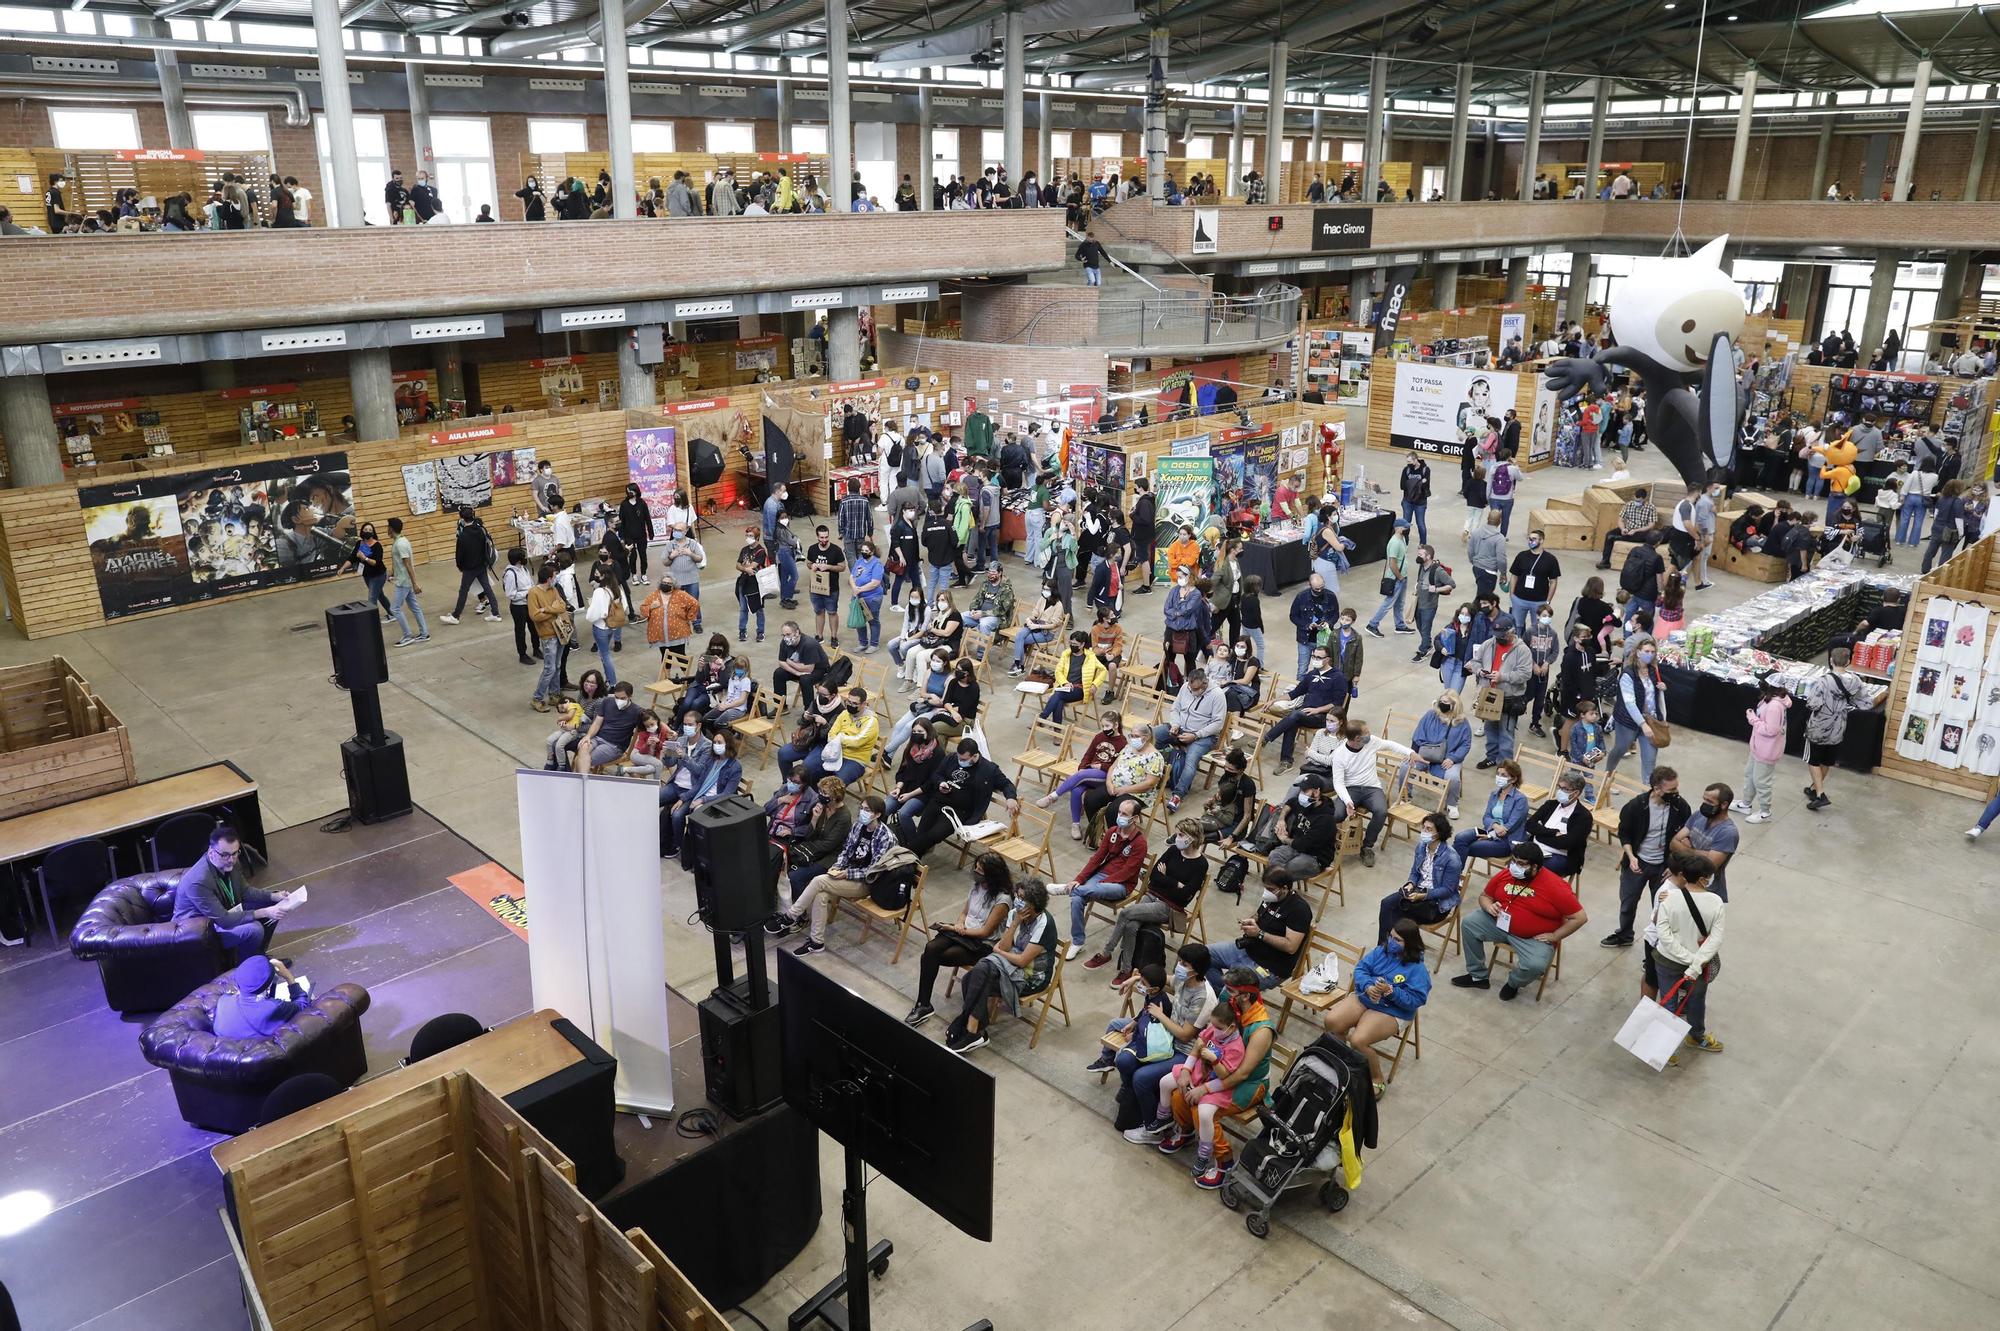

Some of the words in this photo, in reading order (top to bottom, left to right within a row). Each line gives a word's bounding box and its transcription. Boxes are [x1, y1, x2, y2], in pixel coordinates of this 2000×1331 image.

[1323, 223, 1342, 235] fnac
[1342, 223, 1365, 235] Girona
[1381, 283, 1406, 331] fnac
[1424, 378, 1443, 386] PASSA
[1424, 387, 1442, 395] fnac
[448, 431, 467, 441] AULA
[468, 428, 495, 439] MANGA
[1413, 439, 1438, 452] fnac
[293, 463, 313, 472] Temporada
[312, 460, 320, 472] 3
[213, 474, 235, 482] Temporada
[233, 470, 242, 482] 2
[1160, 473, 1186, 482] KAMEN
[1185, 473, 1209, 482] RIDER
[112, 489, 136, 497] Temporada
[136, 484, 143, 496] 1
[105, 550, 164, 572] ATAQUE
